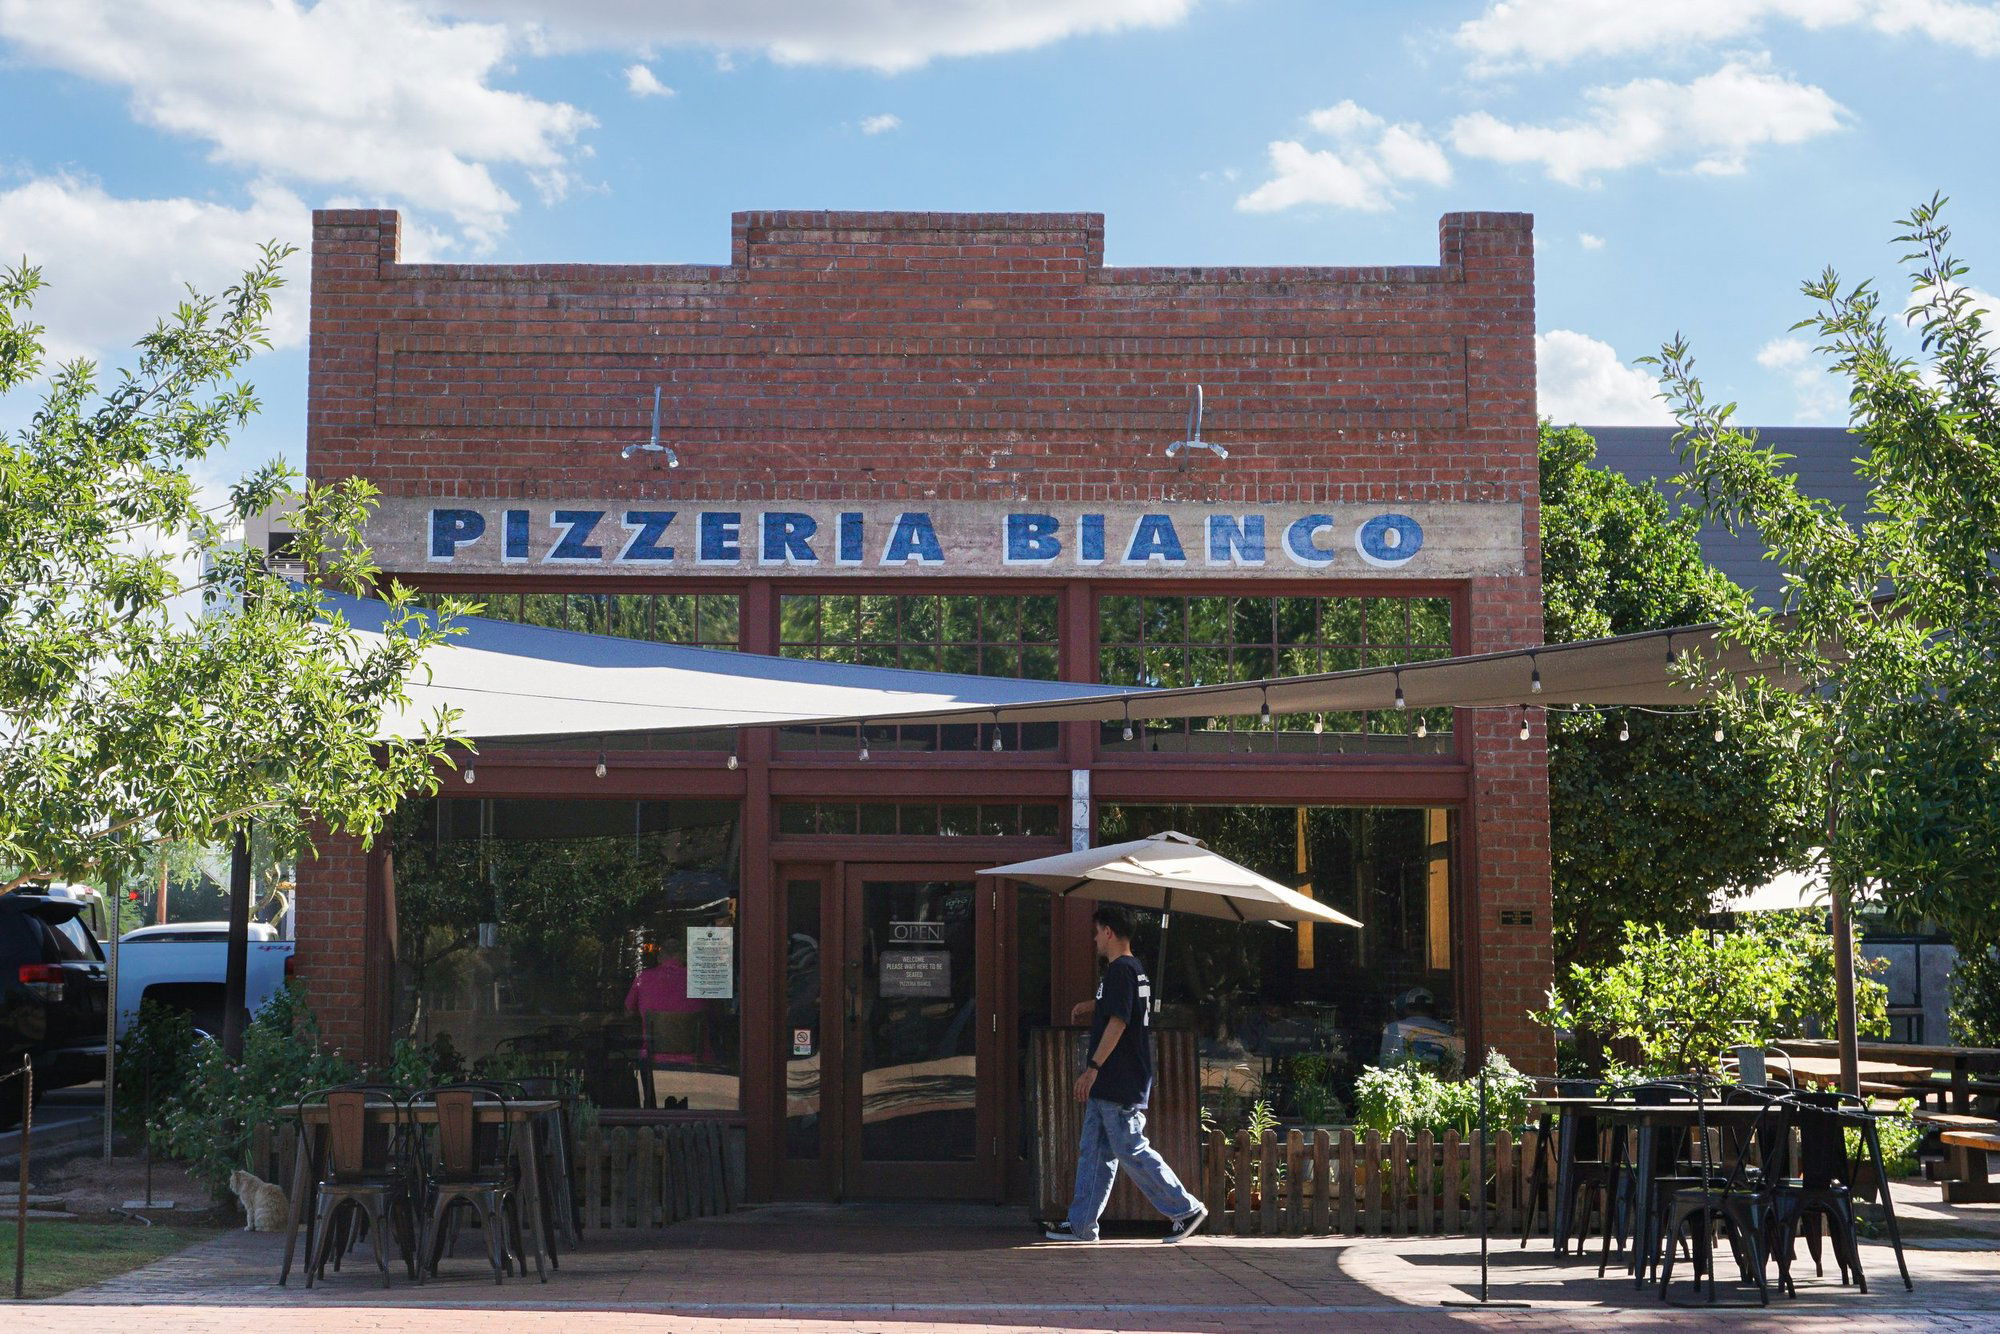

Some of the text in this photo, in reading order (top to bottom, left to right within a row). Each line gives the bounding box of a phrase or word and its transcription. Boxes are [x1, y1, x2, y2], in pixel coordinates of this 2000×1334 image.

[427, 509, 1424, 568] PIZZERIA BIANCO
[894, 925, 940, 940] OPEN
[902, 955, 925, 963] WELCOME
